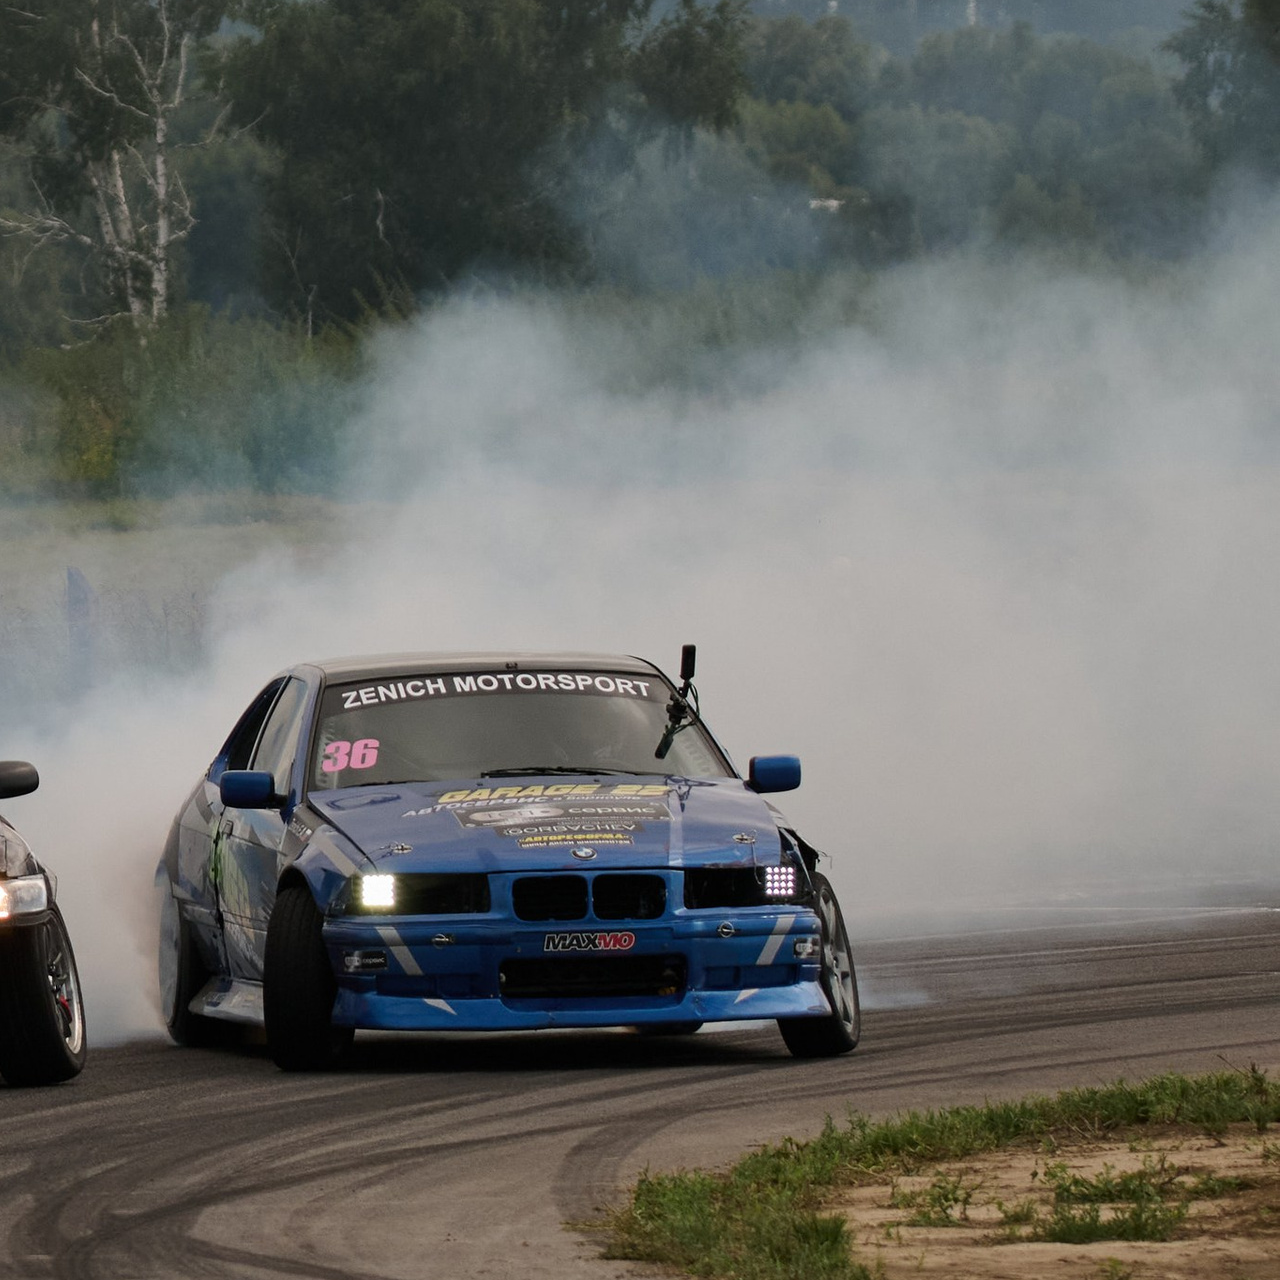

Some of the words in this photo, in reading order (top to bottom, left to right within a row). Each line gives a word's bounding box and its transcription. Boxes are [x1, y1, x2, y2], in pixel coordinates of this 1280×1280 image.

[342, 678, 447, 709] ZENICH
[453, 673, 650, 697] MOTORSPORT
[322, 738, 380, 773] 36
[438, 784, 601, 804] GARAGE
[402, 796, 548, 818] АВТОСЕРВИС
[568, 806, 656, 815] сервис
[544, 932, 635, 951] MAXMO
